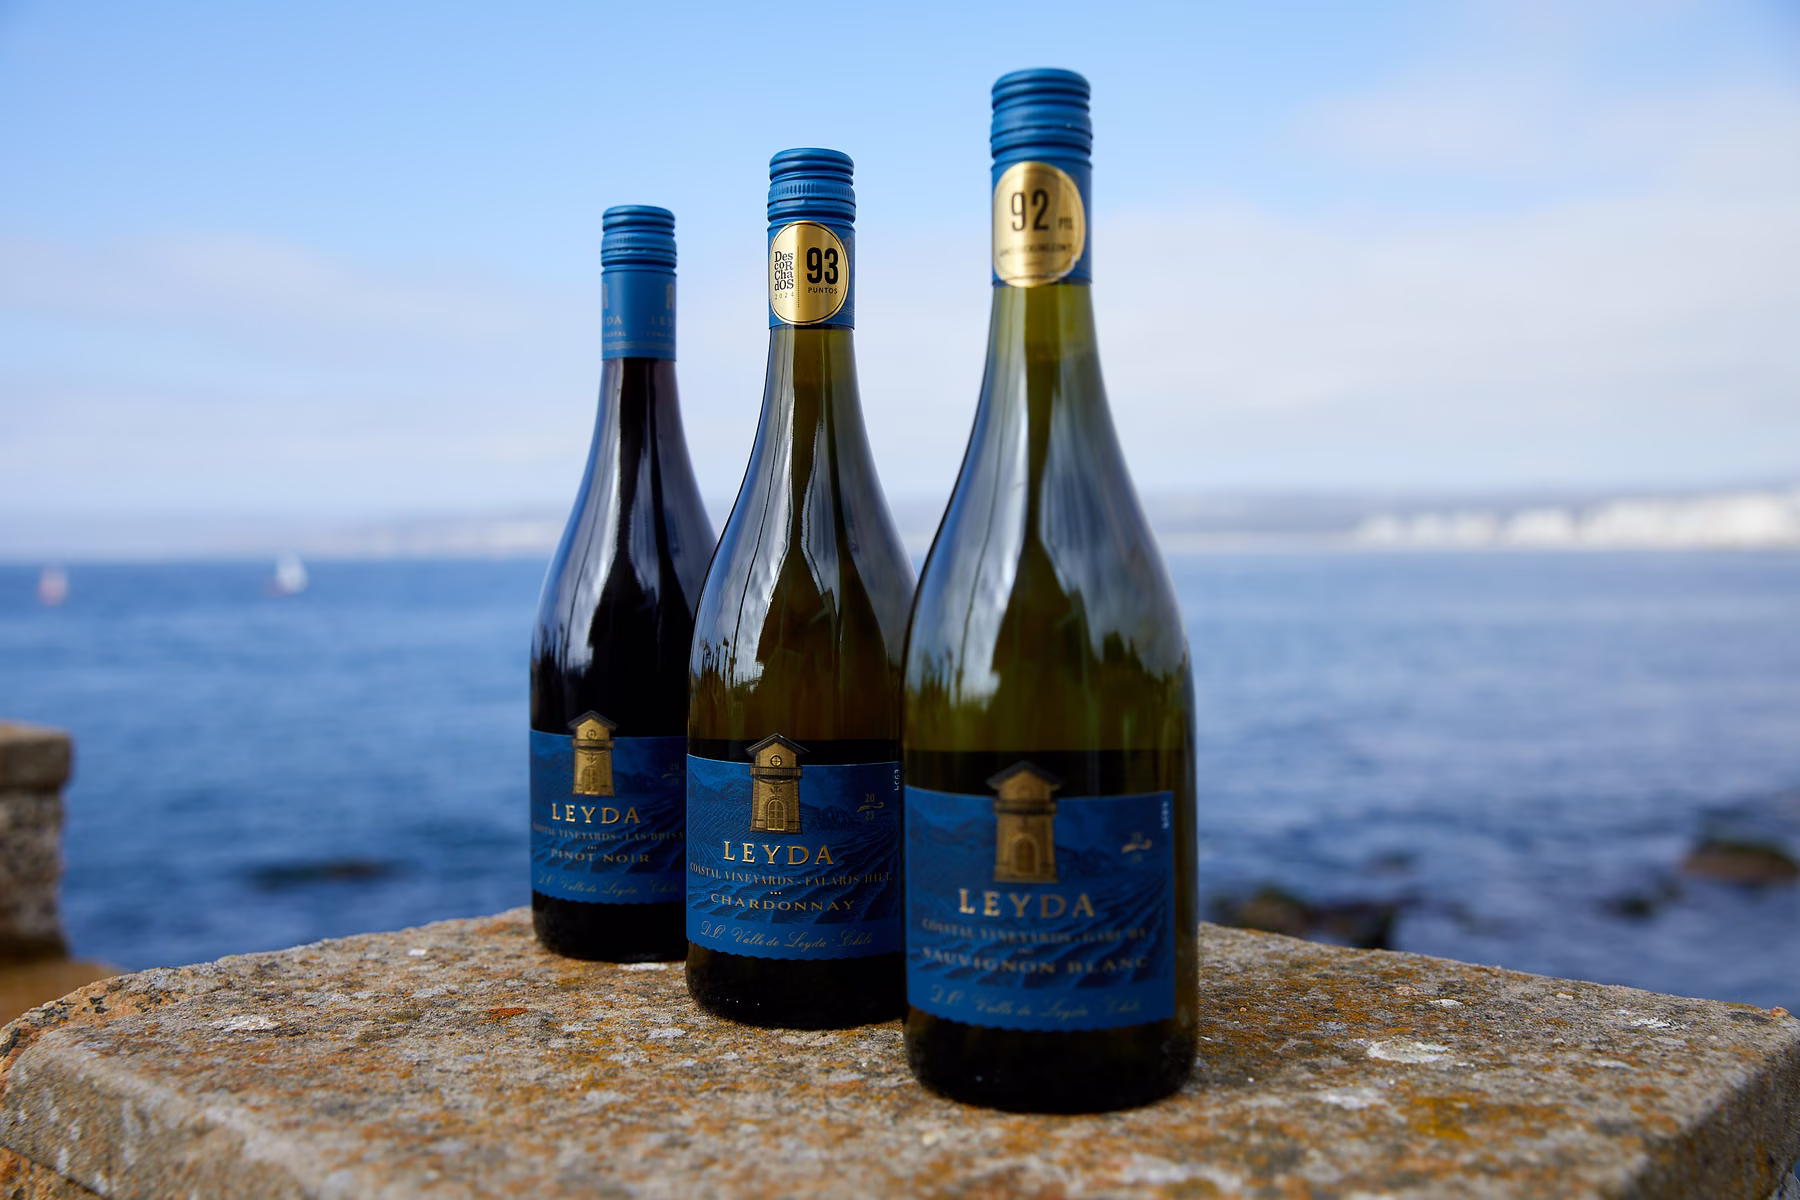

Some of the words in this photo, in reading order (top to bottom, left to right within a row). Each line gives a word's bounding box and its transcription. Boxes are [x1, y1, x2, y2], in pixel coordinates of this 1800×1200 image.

[1011, 188, 1049, 232] 92
[806, 246, 839, 285] 93
[808, 286, 838, 295] PUNTOS
[865, 793, 875, 803] 20
[552, 803, 640, 824] LEYDA
[559, 829, 616, 841] VINEYARDS
[551, 849, 595, 863] PINOT
[603, 853, 649, 864] NOIR
[723, 840, 834, 865] LEYDA
[690, 861, 721, 879] COASTAL
[725, 871, 793, 885] VINEYARDS
[864, 872, 892, 883] HILL
[710, 893, 855, 912] CHARDONNAY
[959, 888, 1095, 918] LEYDA
[731, 927, 766, 945] Valle
[766, 936, 779, 946] de
[783, 931, 828, 952] Leyda
[922, 946, 1057, 974] SAUVIGNON
[1067, 956, 1149, 974] BLANC
